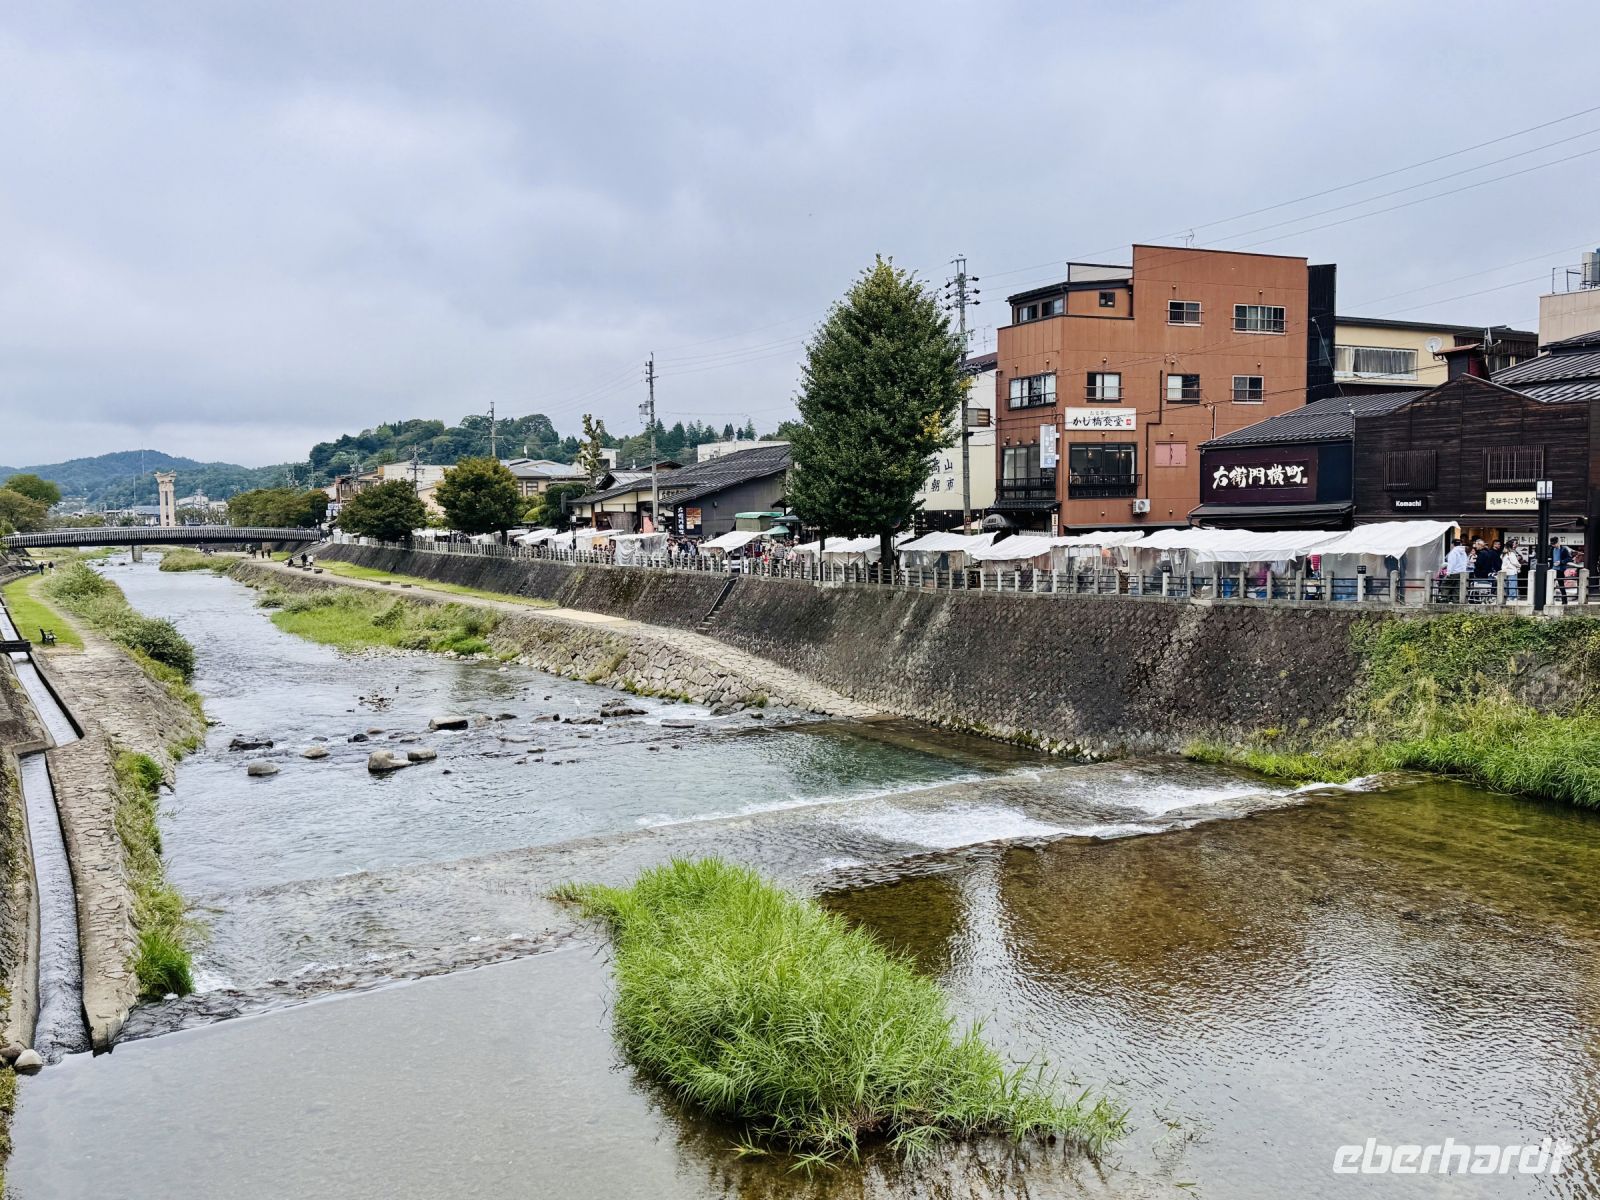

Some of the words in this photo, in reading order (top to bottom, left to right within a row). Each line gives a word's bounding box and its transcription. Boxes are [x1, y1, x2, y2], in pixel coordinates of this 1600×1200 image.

[1073, 416, 1123, 427] かじ橋食堂
[1212, 464, 1304, 489] 右衛門横町
